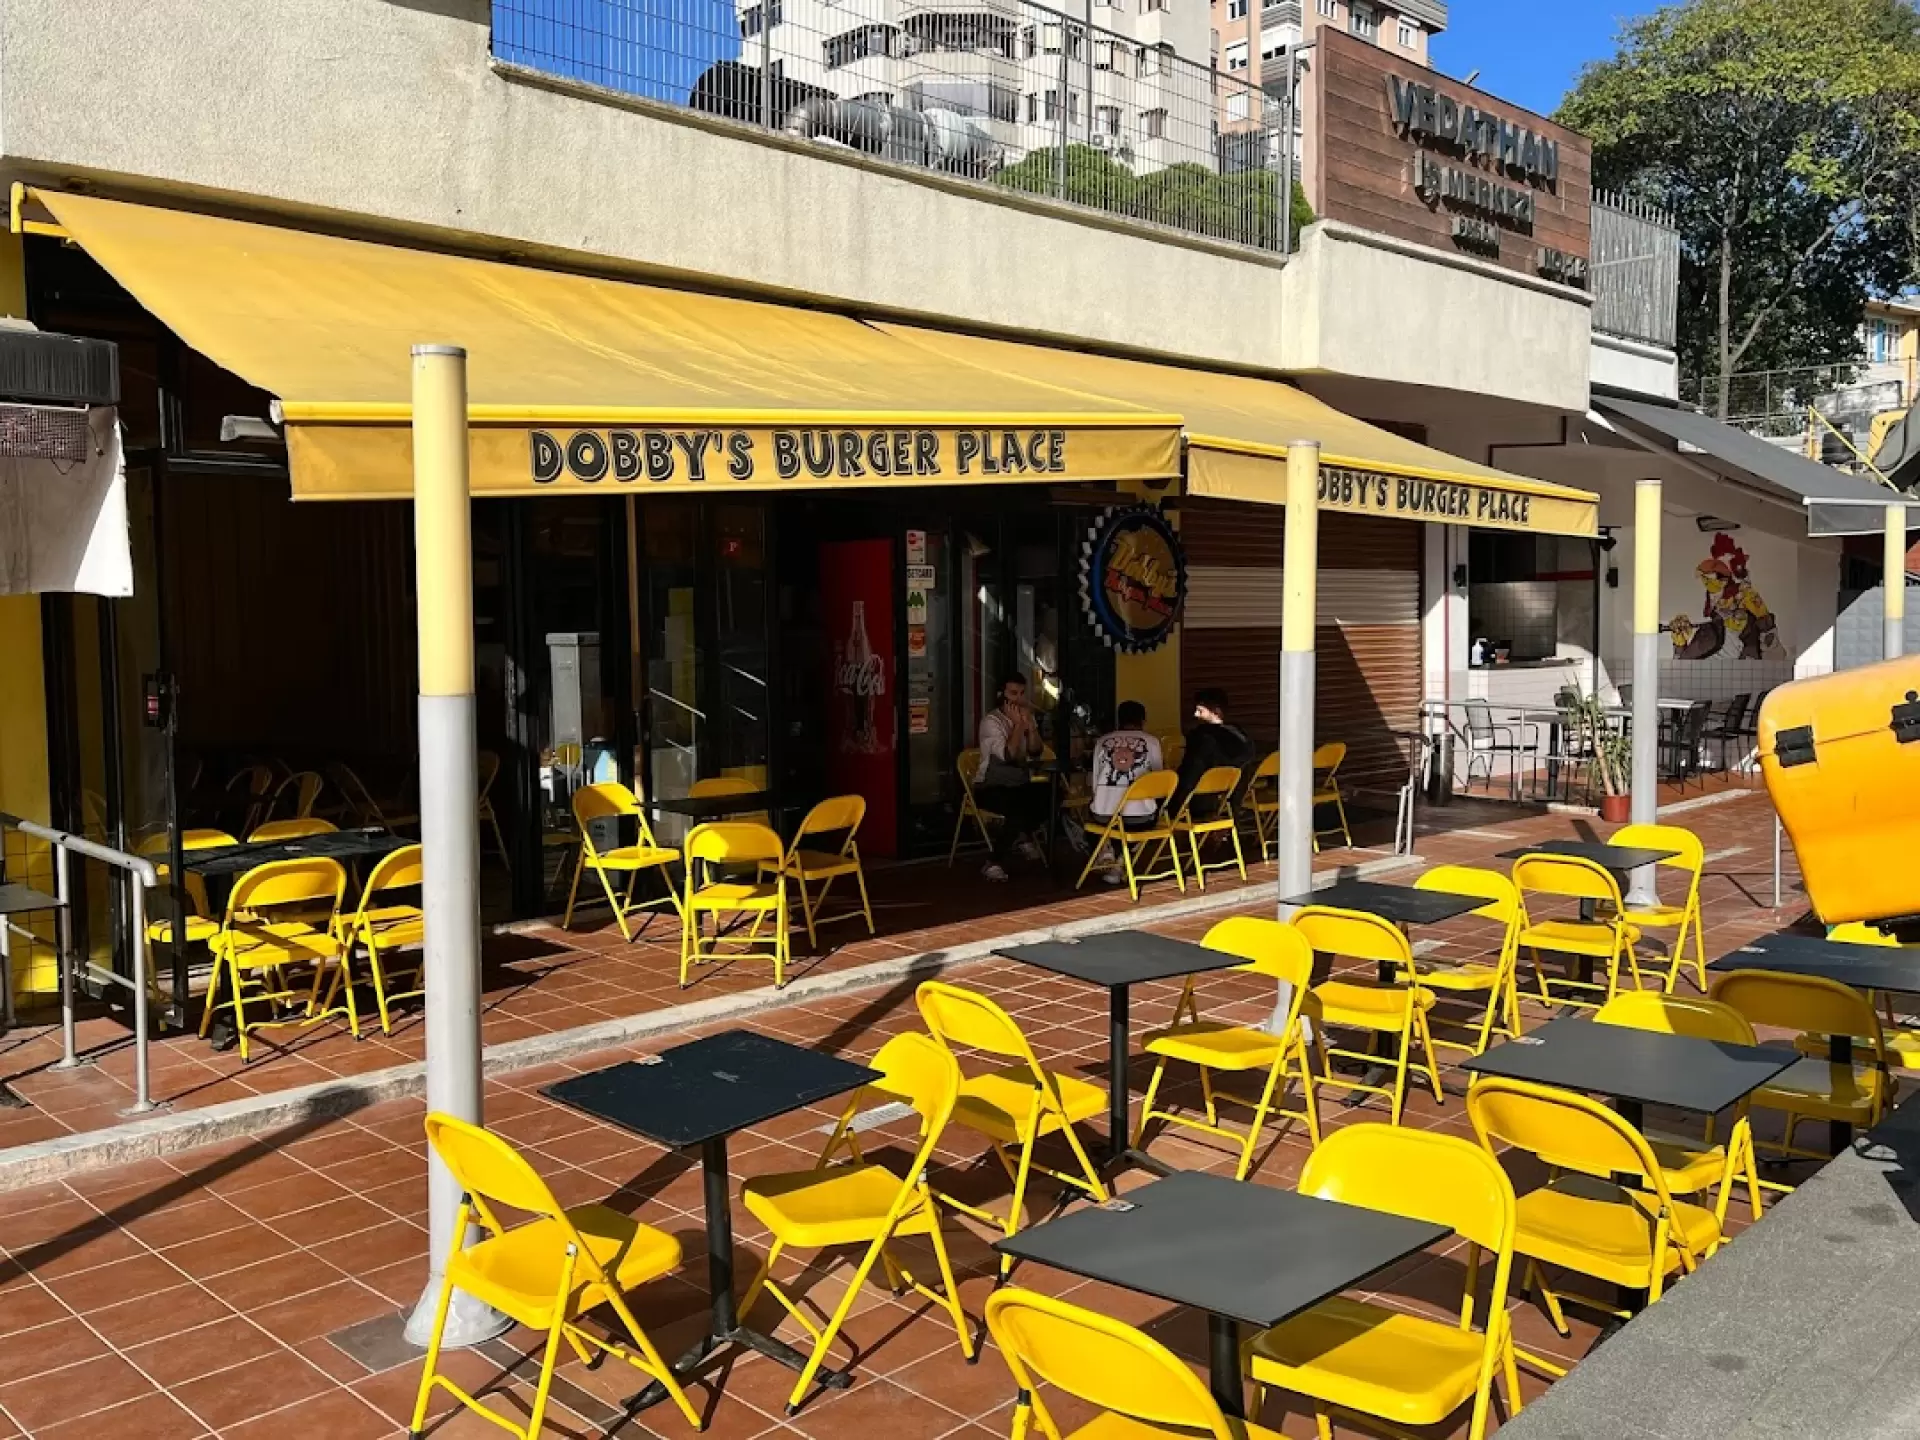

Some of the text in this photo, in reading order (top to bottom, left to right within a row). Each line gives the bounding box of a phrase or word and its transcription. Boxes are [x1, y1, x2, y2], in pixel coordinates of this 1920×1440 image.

[1385, 74, 1558, 181] VEDATHAN
[529, 428, 1066, 483] DOBBY'S BURGER PLACE
[1318, 468, 1530, 526] OBBY'S BURGER PLACE
